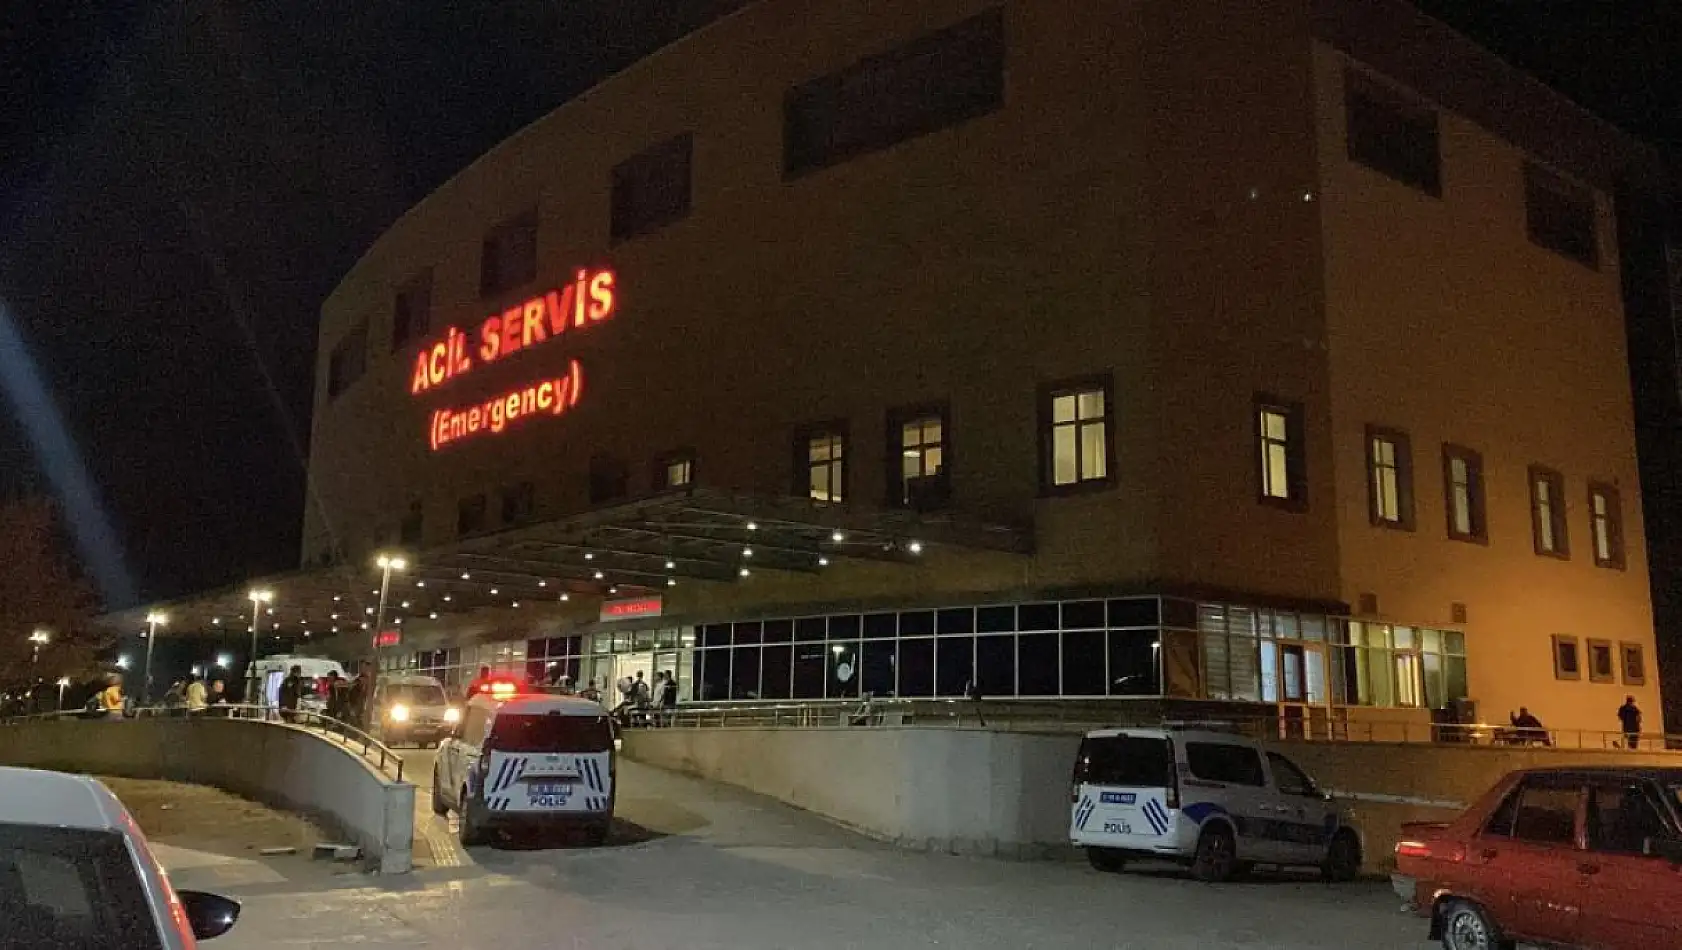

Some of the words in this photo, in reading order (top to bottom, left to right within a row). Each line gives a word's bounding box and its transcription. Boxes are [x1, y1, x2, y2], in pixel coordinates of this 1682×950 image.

[411, 326, 471, 395] ACİL
[480, 269, 615, 361] SERVİS
[430, 358, 582, 450] (Emergency)
